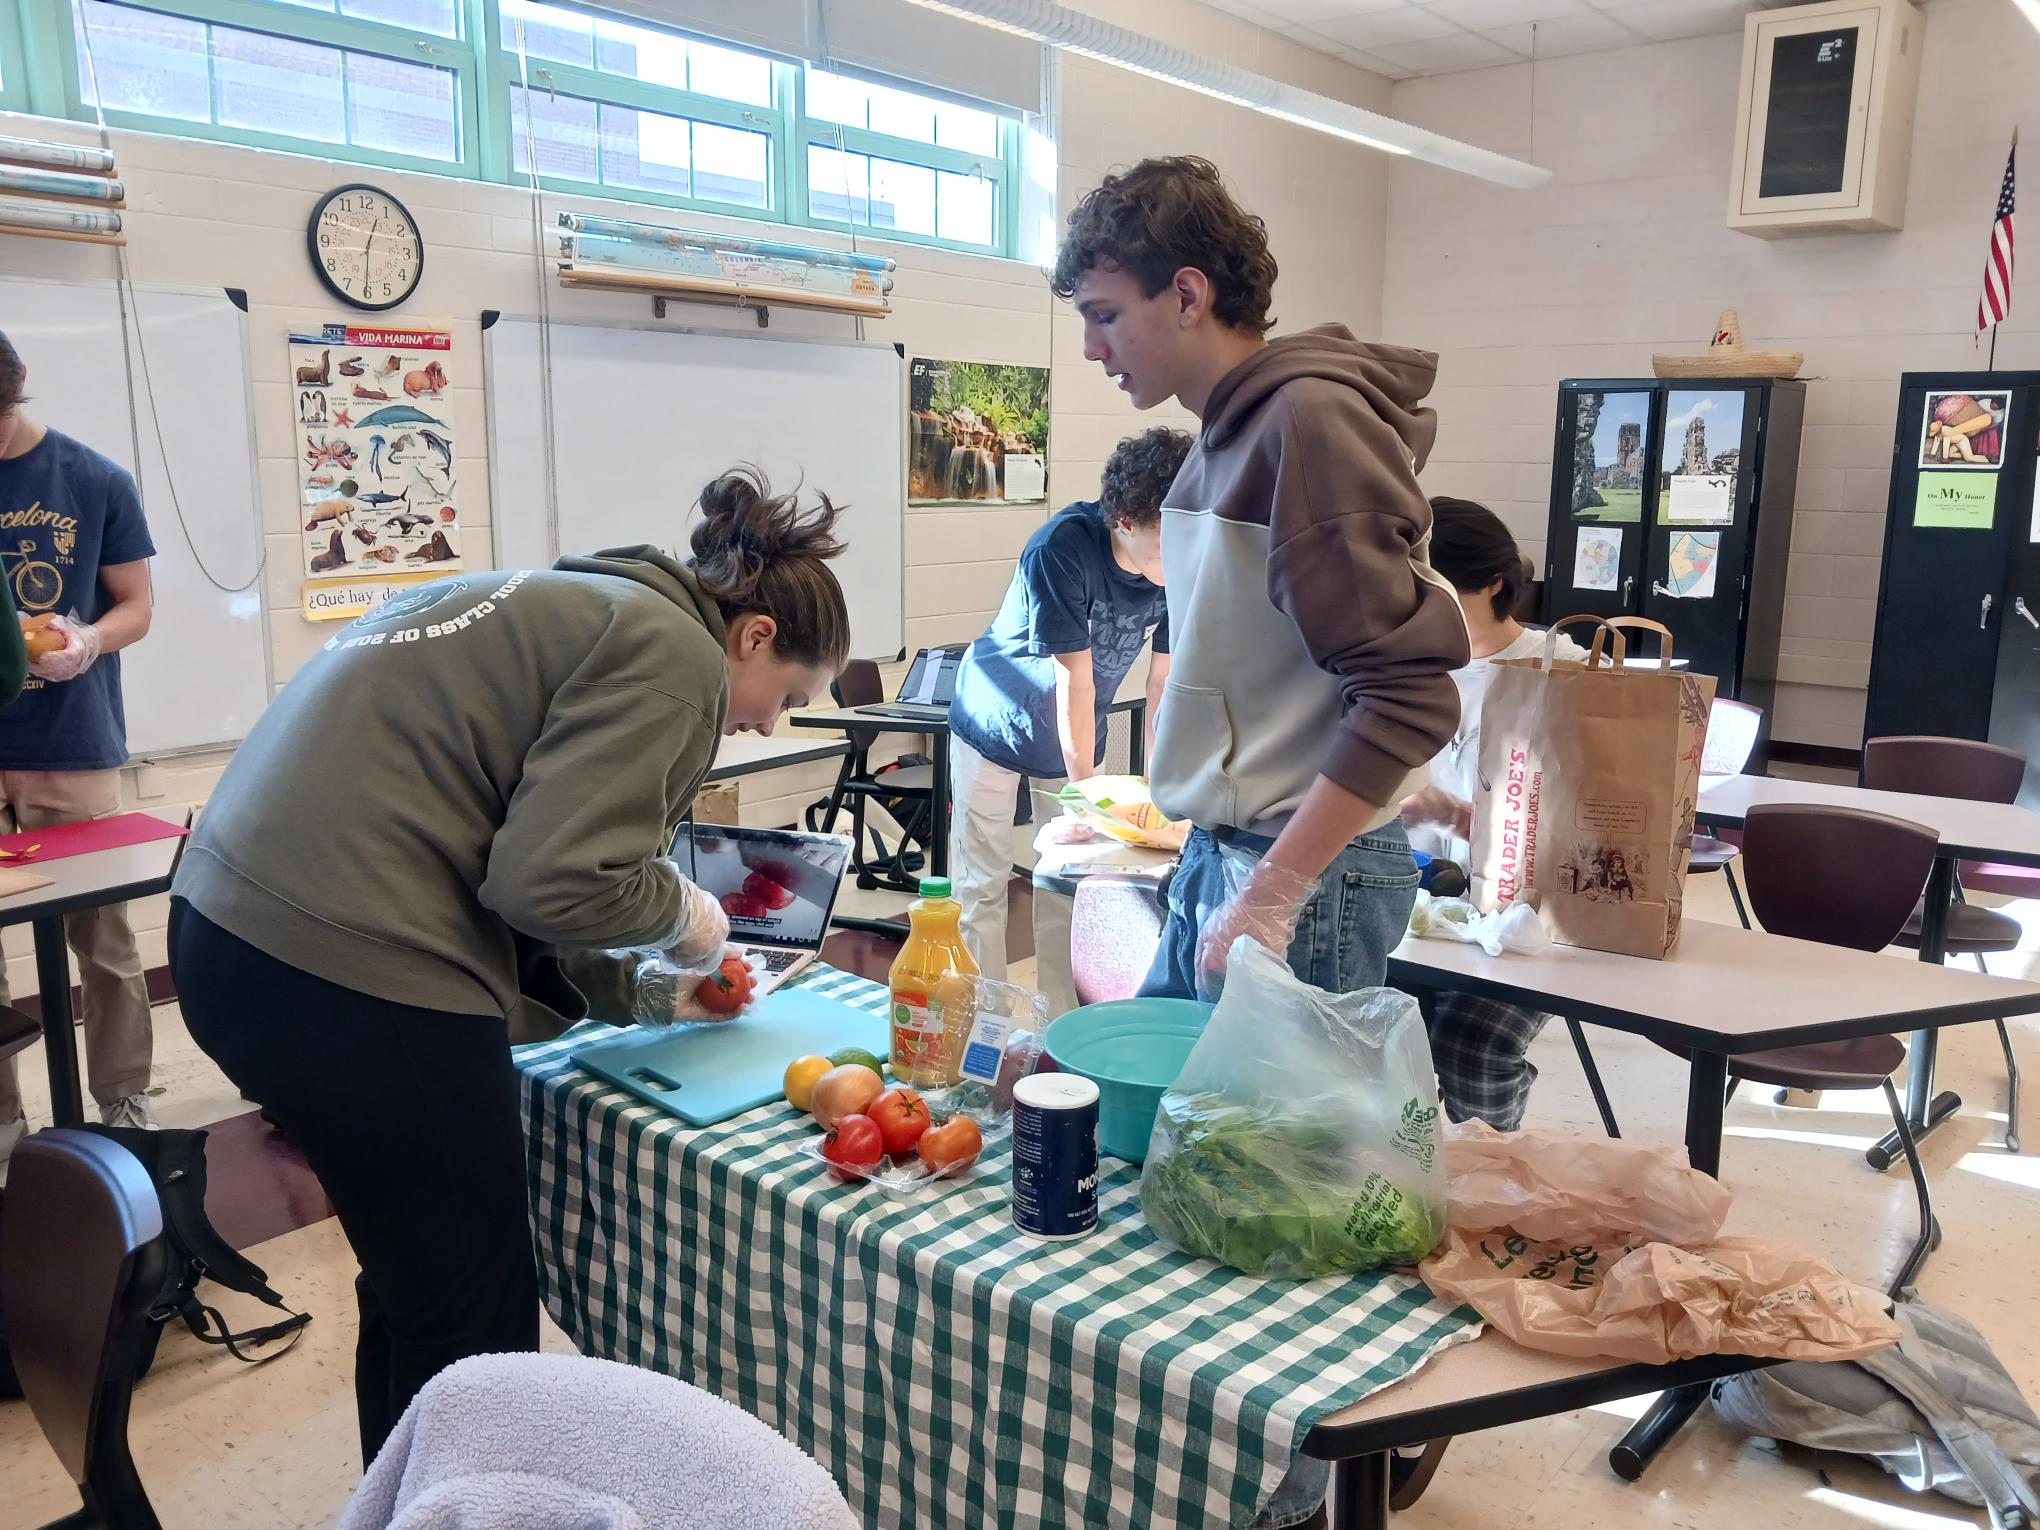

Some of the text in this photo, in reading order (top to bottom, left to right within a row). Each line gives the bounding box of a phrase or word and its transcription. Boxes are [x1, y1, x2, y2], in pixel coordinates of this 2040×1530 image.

[338, 197, 353, 212] 11
[358, 195, 374, 211] 12
[323, 212, 339, 227] 10
[383, 206, 389, 219] 1
[396, 224, 405, 238] 2
[320, 234, 330, 248] 9
[402, 247, 411, 261] 3
[327, 258, 336, 272] 8
[398, 268, 407, 281] 4
[343, 277, 352, 291] 7
[383, 282, 392, 296] 5
[363, 285, 372, 299] 6
[358, 332, 423, 345] VIDA MARINA
[913, 364, 926, 376] EF
[1940, 488, 1963, 502] My
[55, 555, 74, 565] 1714
[308, 589, 345, 609] ¿Qué
[349, 589, 375, 607] hay
[425, 600, 496, 639] CLASS
[389, 628, 420, 644] OF
[1498, 748, 1526, 902] TRADER JOE'S
